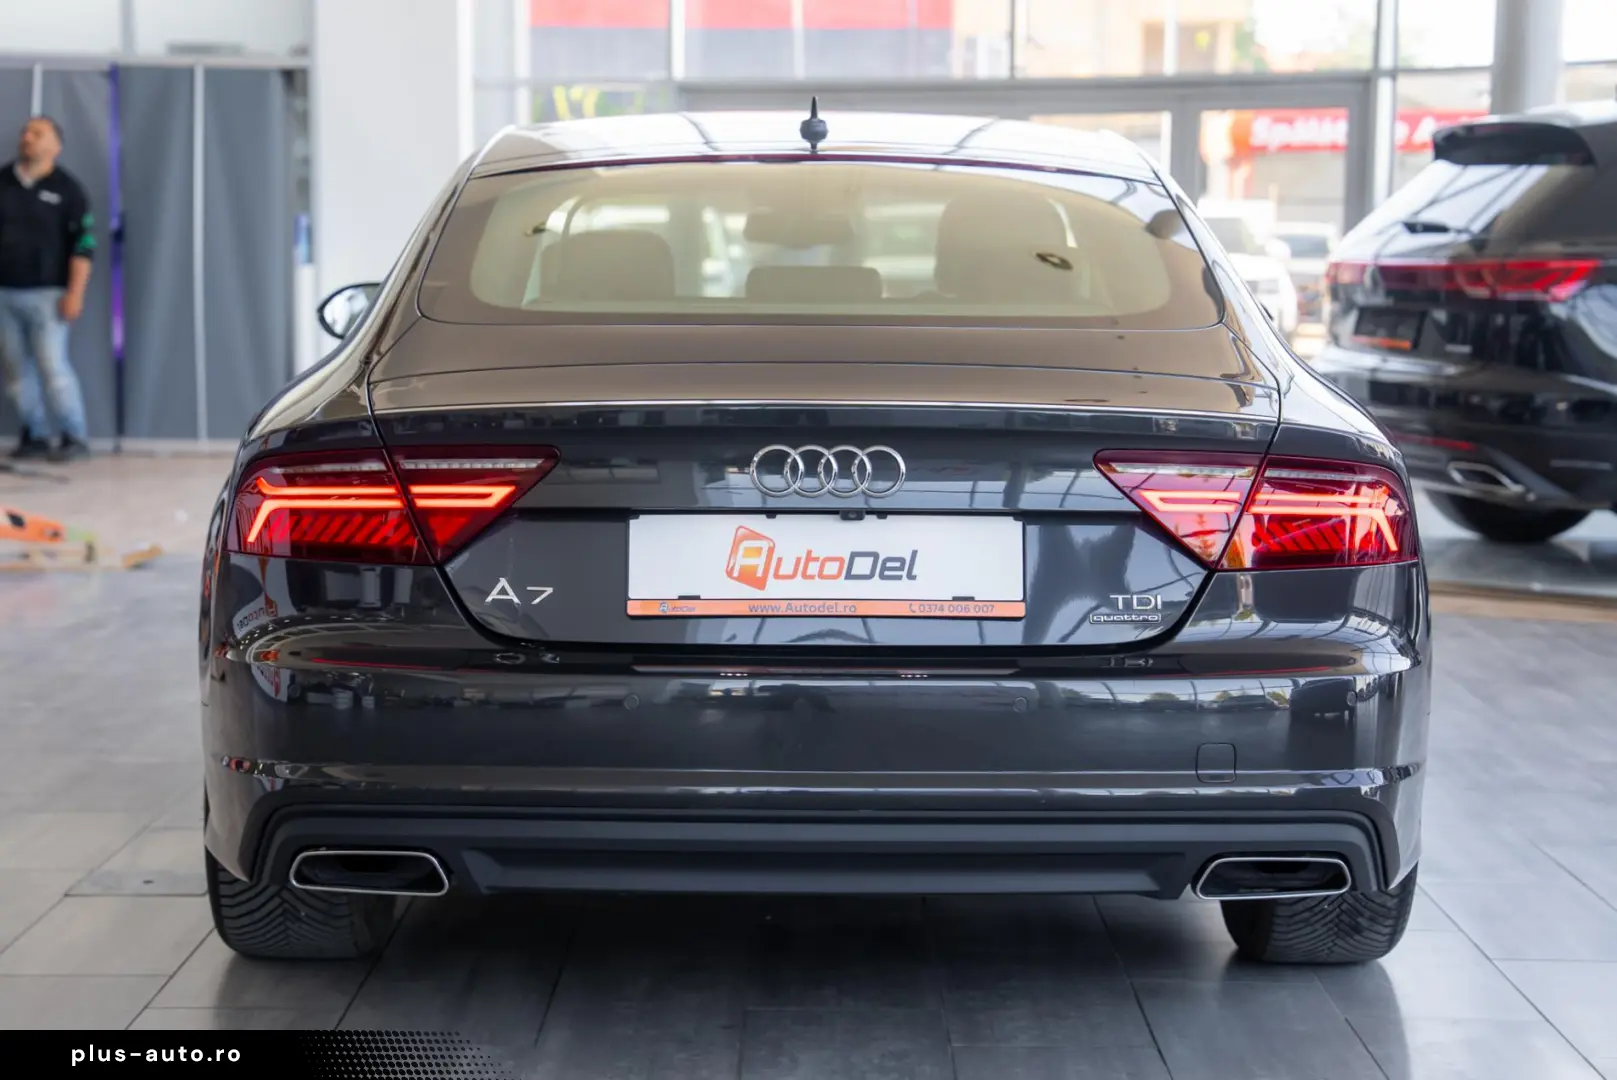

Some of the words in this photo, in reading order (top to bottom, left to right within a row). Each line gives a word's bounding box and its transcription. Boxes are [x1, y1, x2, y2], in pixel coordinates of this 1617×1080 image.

[726, 525, 918, 591] AutoDel
[748, 602, 857, 613] www.Autodel.ro
[1109, 594, 1162, 610] TDI
[918, 603, 945, 613] 0374
[947, 603, 971, 613] 006
[973, 603, 995, 613] 007
[1092, 613, 1160, 623] quattro
